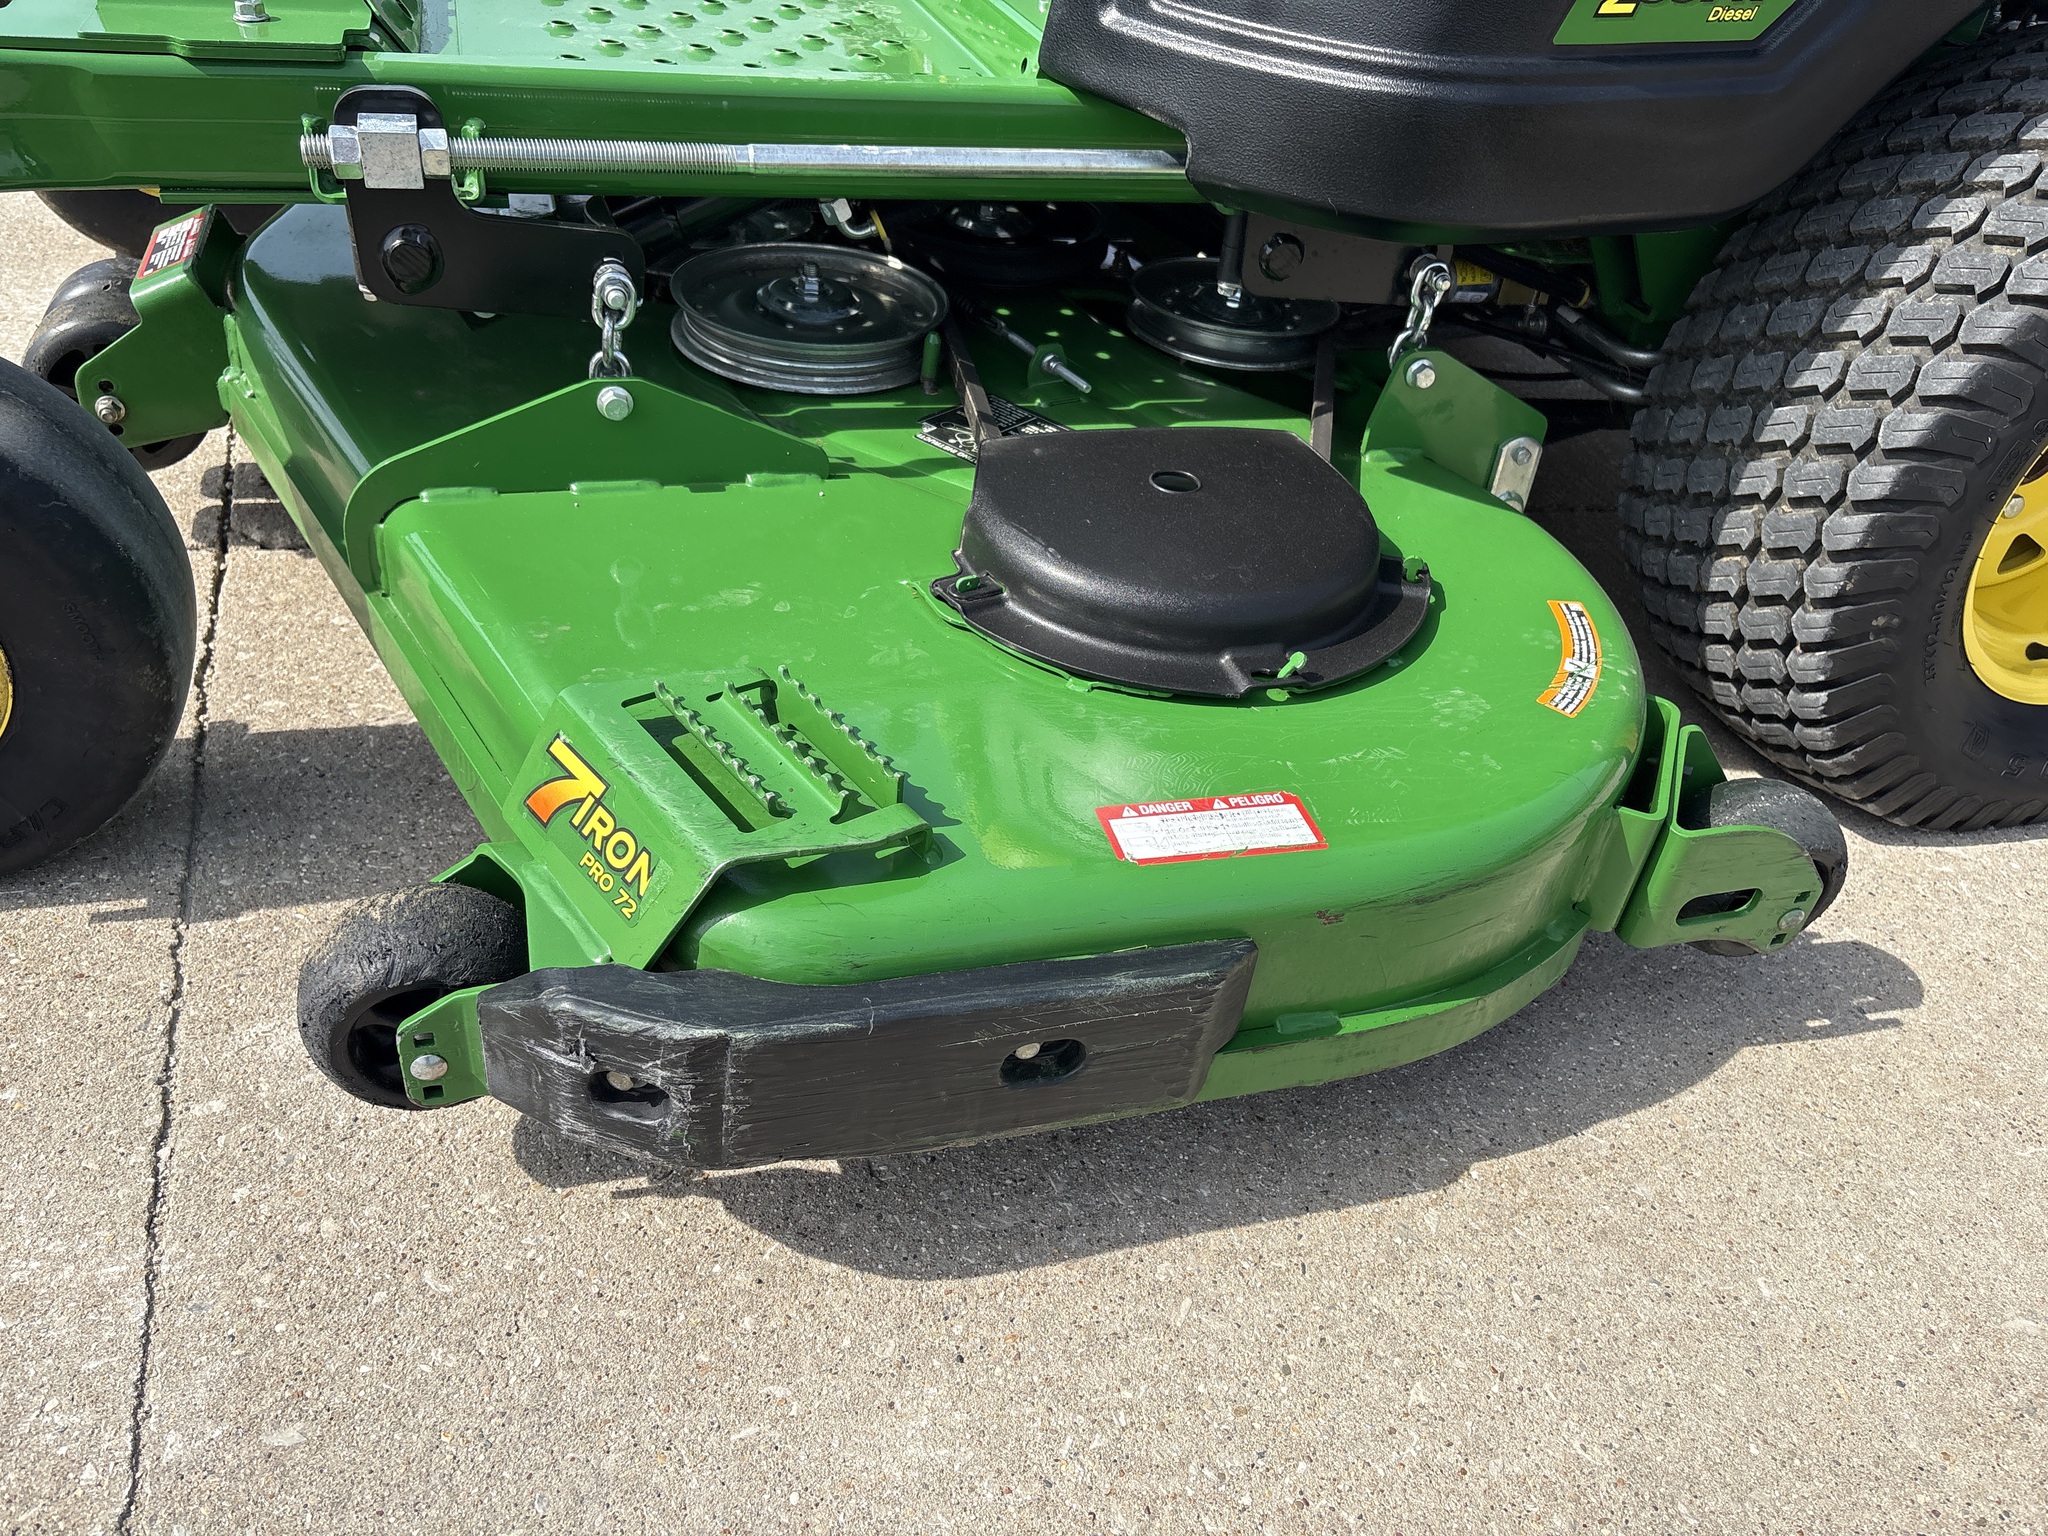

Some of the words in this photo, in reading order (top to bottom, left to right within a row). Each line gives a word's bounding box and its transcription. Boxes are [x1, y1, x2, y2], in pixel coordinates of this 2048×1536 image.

[1706, 6, 1759, 22] Diesel
[1138, 801, 1194, 815] DANGER
[1228, 792, 1285, 807] PELIGRO
[579, 850, 615, 893] PRO
[612, 887, 638, 920] 72
